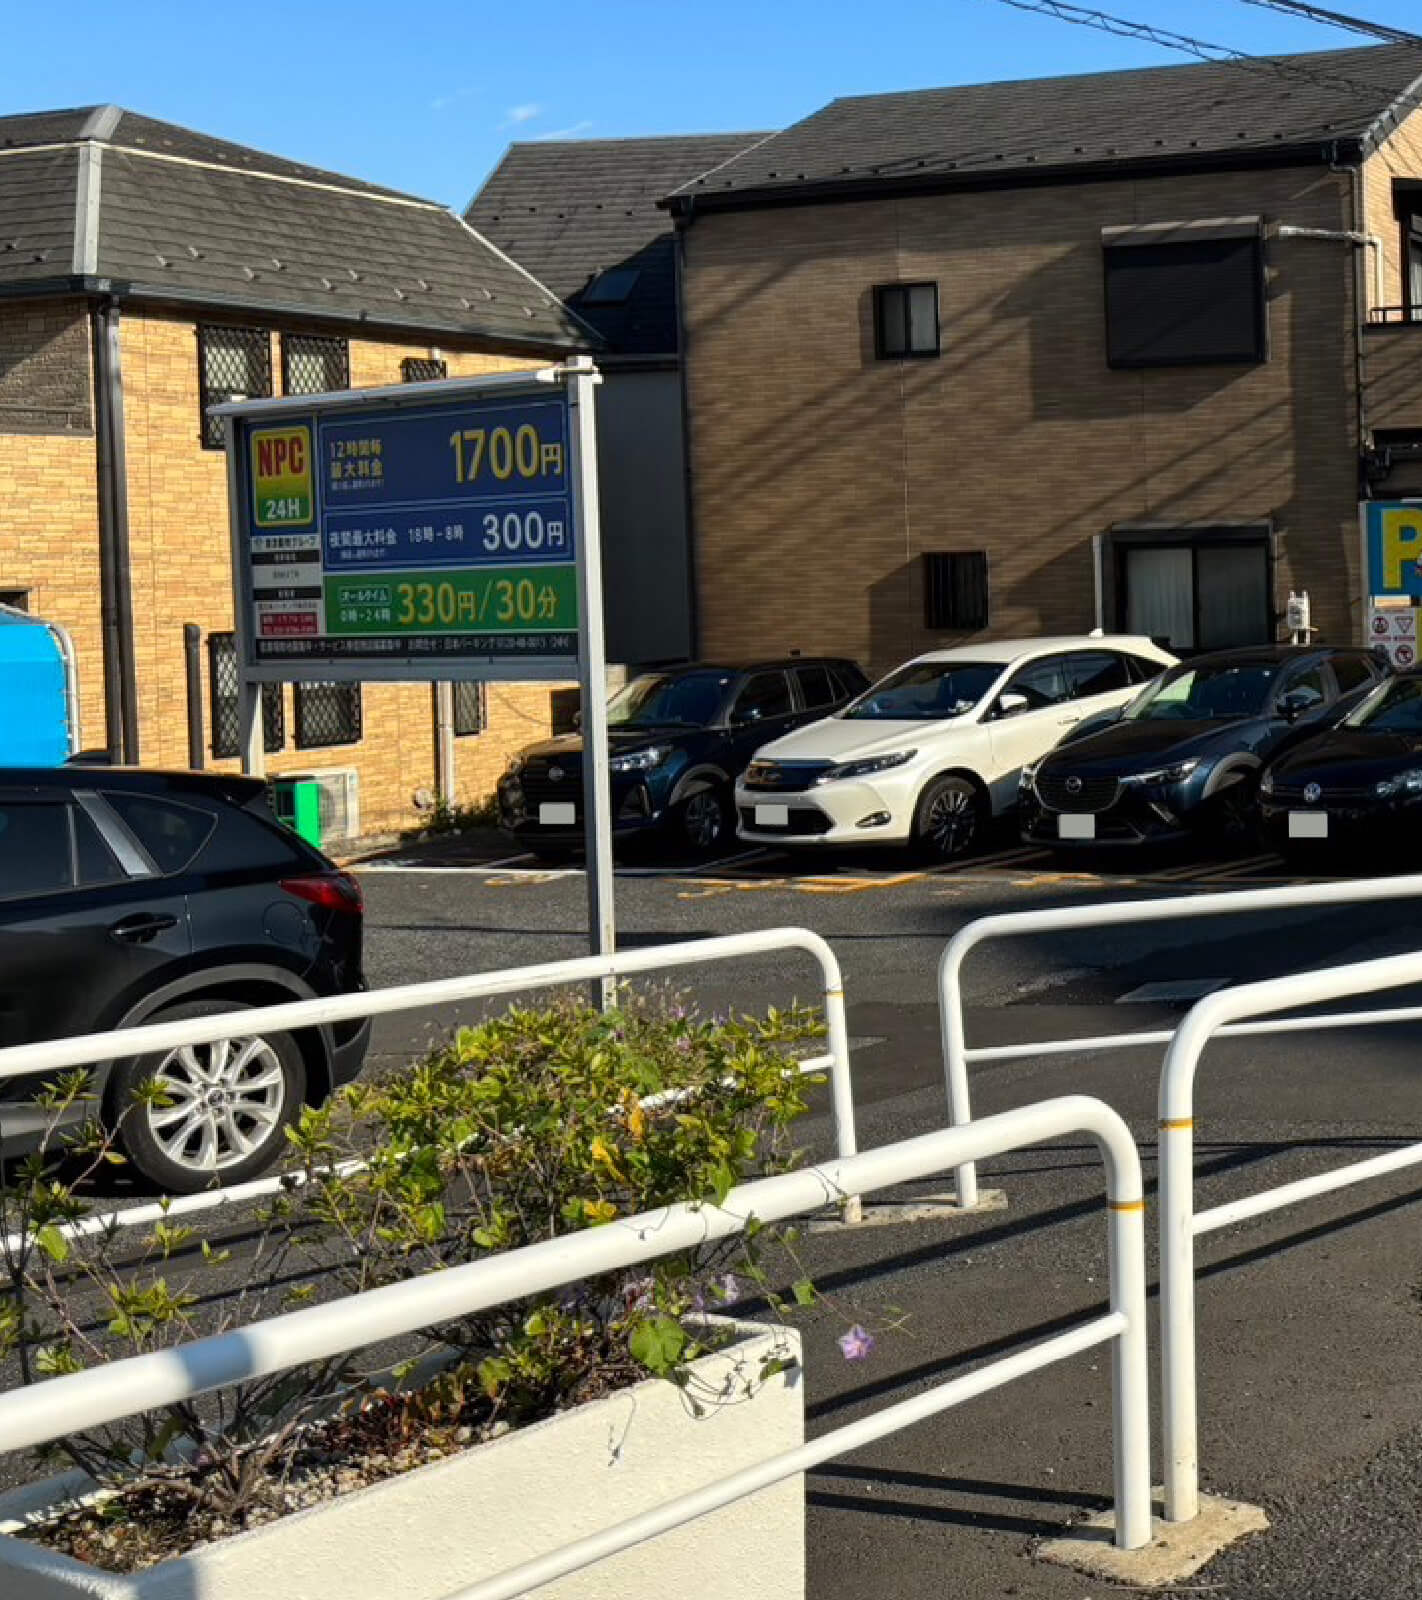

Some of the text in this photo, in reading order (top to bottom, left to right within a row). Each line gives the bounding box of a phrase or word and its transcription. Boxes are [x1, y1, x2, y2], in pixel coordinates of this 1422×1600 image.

[257, 437, 305, 478] NPC
[450, 425, 563, 483] 1700円
[265, 496, 300, 521] 24H
[483, 511, 564, 551] 300円
